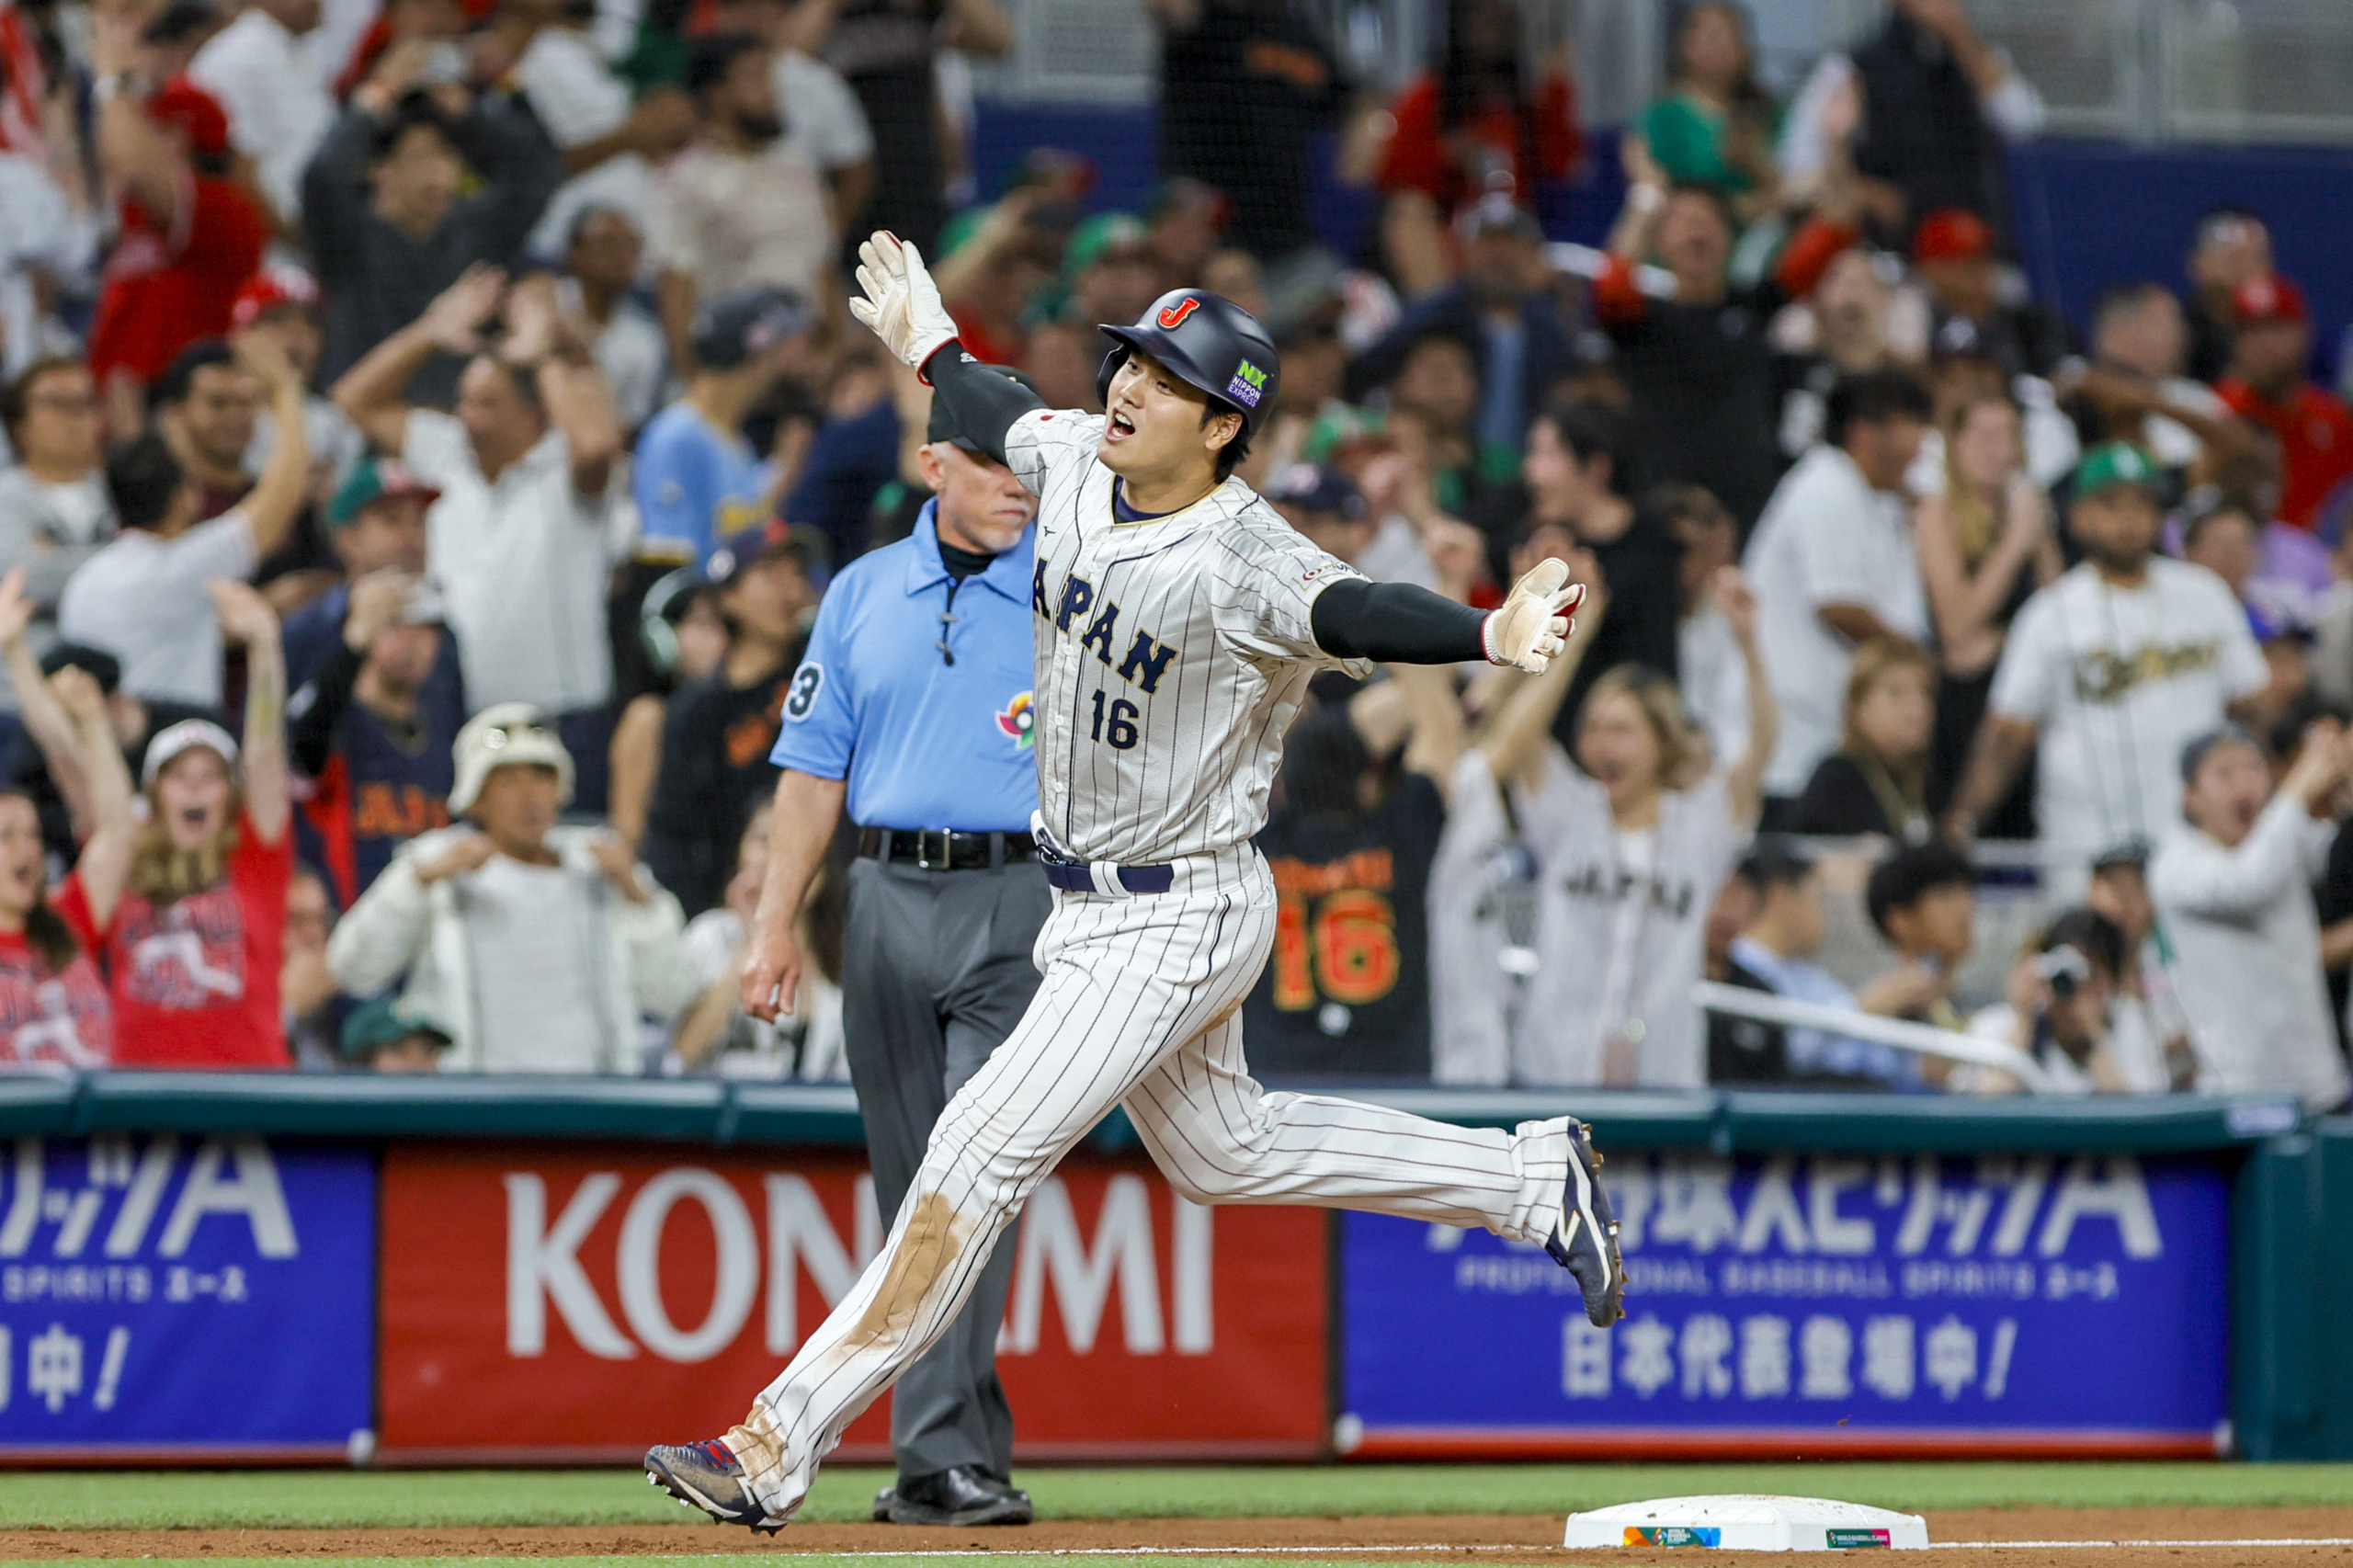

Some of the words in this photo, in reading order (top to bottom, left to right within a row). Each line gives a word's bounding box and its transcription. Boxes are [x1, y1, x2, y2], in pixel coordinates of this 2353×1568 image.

[1157, 297, 1200, 329] J
[1228, 383, 1257, 407] EXPRESS
[1232, 376, 1261, 401] NIPPON
[1237, 359, 1267, 391] NX
[1033, 556, 1180, 696] APAN
[1091, 688, 1140, 750] 16
[1273, 888, 1401, 1012] 16
[502, 1167, 1214, 1364] KONMI
